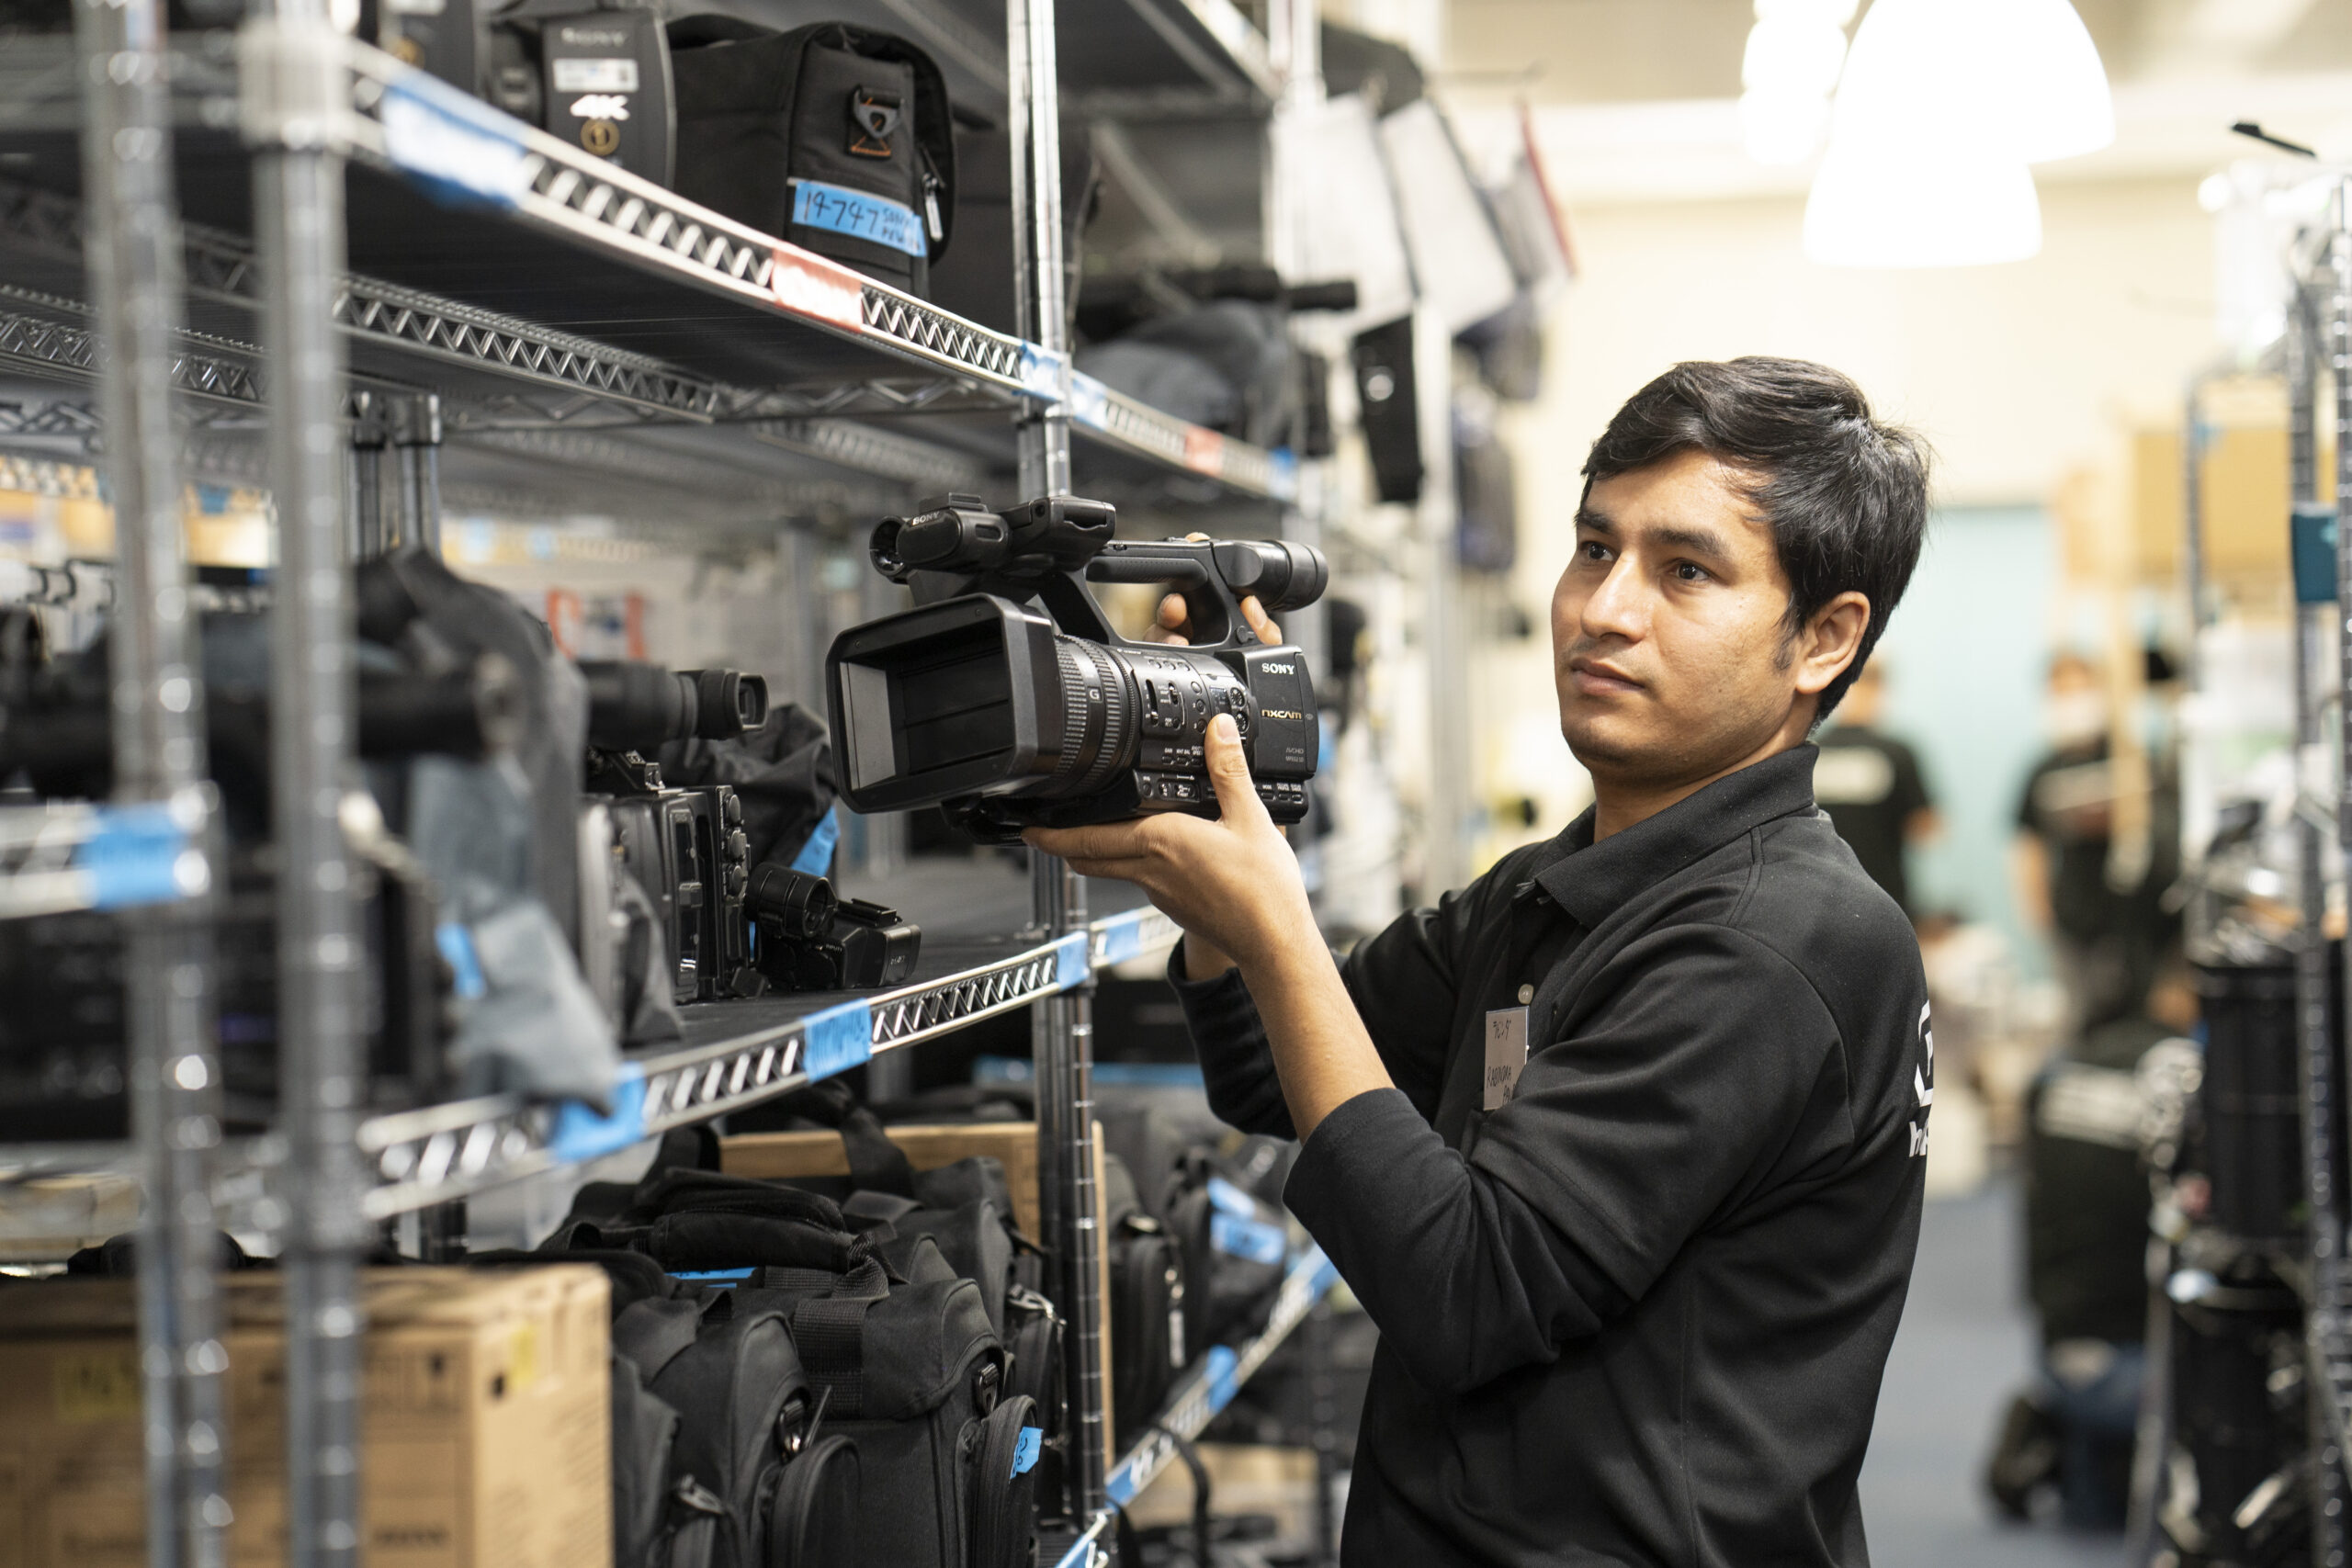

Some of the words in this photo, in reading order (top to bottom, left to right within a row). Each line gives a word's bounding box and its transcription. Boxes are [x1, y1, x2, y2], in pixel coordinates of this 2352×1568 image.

[570, 94, 630, 121] 4K
[912, 511, 940, 525] SONY
[1261, 662, 1295, 675] SONY
